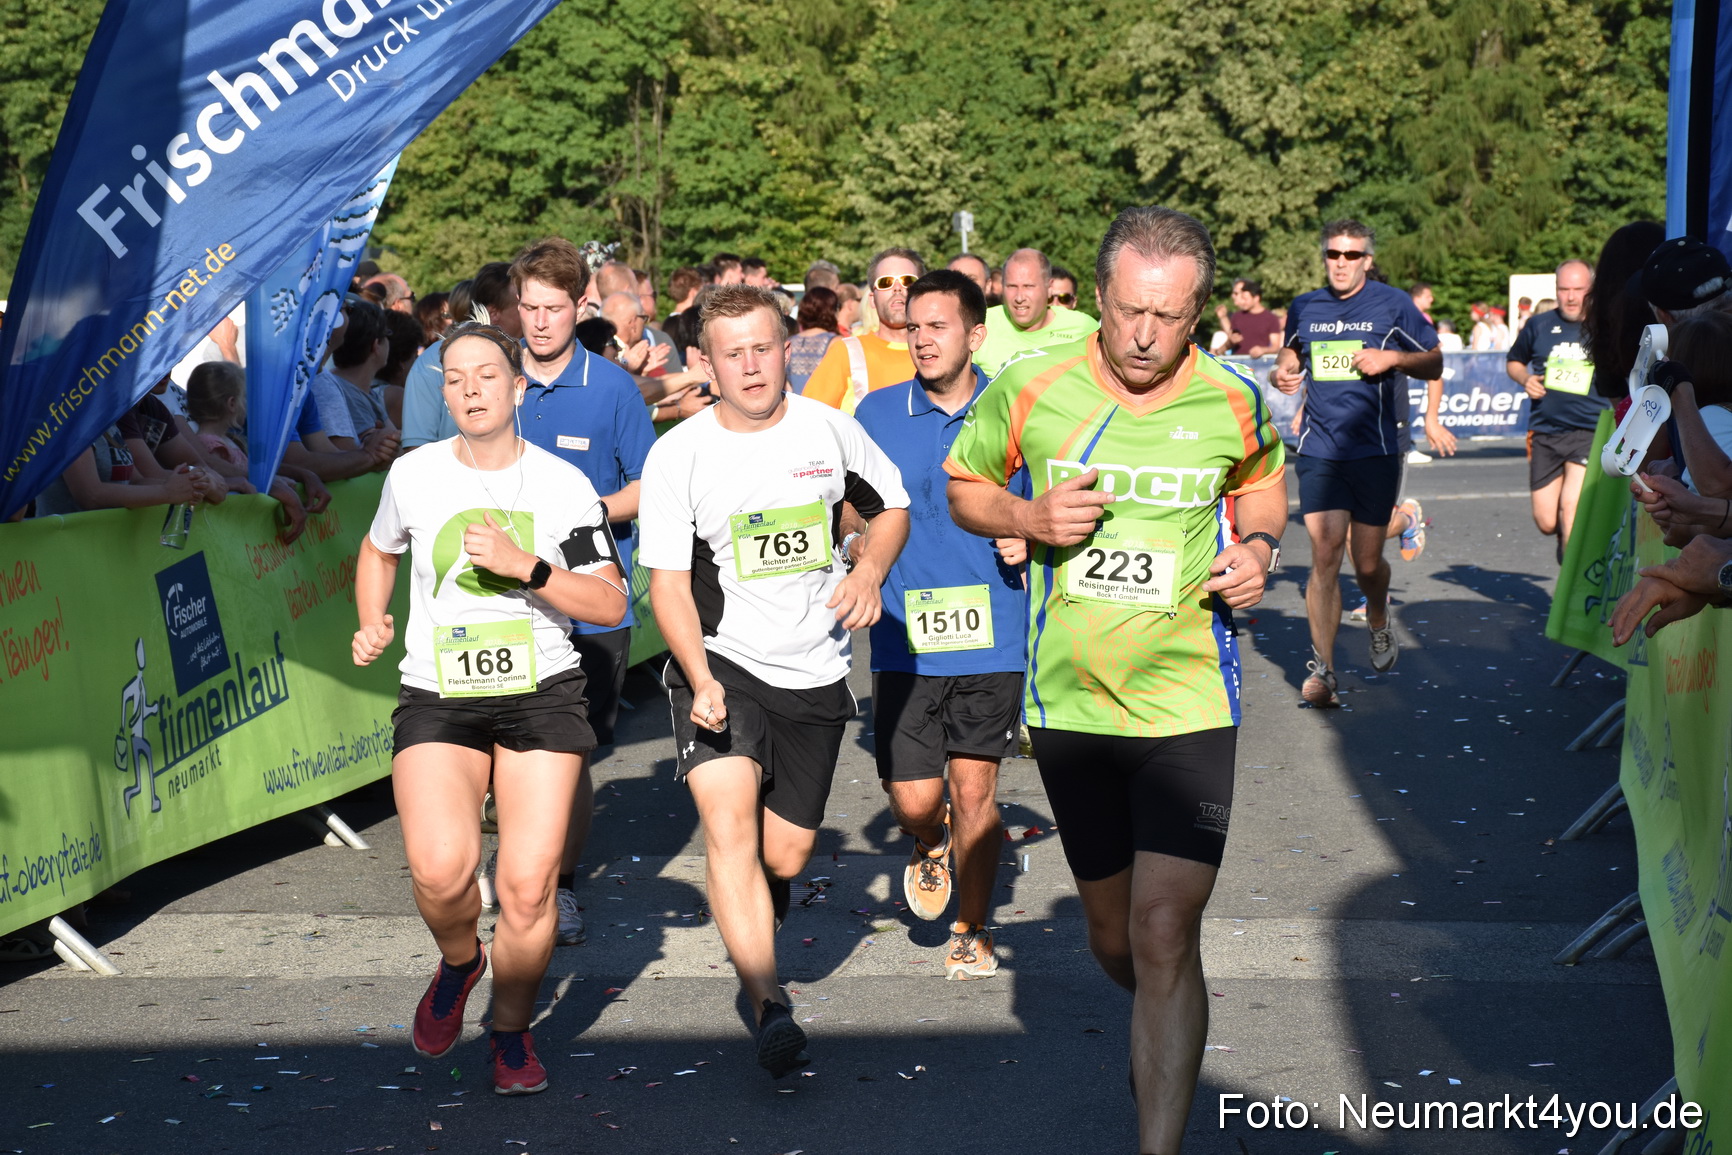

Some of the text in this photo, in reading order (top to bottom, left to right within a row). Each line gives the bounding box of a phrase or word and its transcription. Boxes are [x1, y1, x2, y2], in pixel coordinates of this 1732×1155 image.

[326, 0, 452, 102] Druck u
[76, 0, 391, 259] Frischma
[3, 242, 237, 483] www.frischmann-net.de
[1322, 355, 1356, 370] 520
[1554, 368, 1581, 384] 275
[1412, 412, 1518, 428] ATOMOBILE
[799, 468, 834, 478] partner
[753, 530, 809, 559] 763
[1094, 531, 1119, 540] enlauf
[751, 565, 784, 574] guttenberger
[784, 562, 801, 570] partner
[762, 555, 806, 567] Richter Alex
[1085, 548, 1153, 584] 223
[1078, 579, 1160, 596] Reisinger Helmuth
[1096, 591, 1111, 599] Bock
[1118, 593, 1138, 601] GmbH
[173, 597, 207, 628] Fischer
[917, 608, 980, 634] 1510
[180, 616, 208, 639] AUTOMOBILE
[928, 634, 954, 642] Gigliotti
[457, 647, 514, 677] 168
[448, 674, 526, 686] Fleischmann Corinna
[159, 631, 289, 768] firmenlauf
[168, 744, 222, 799] neumarkt
